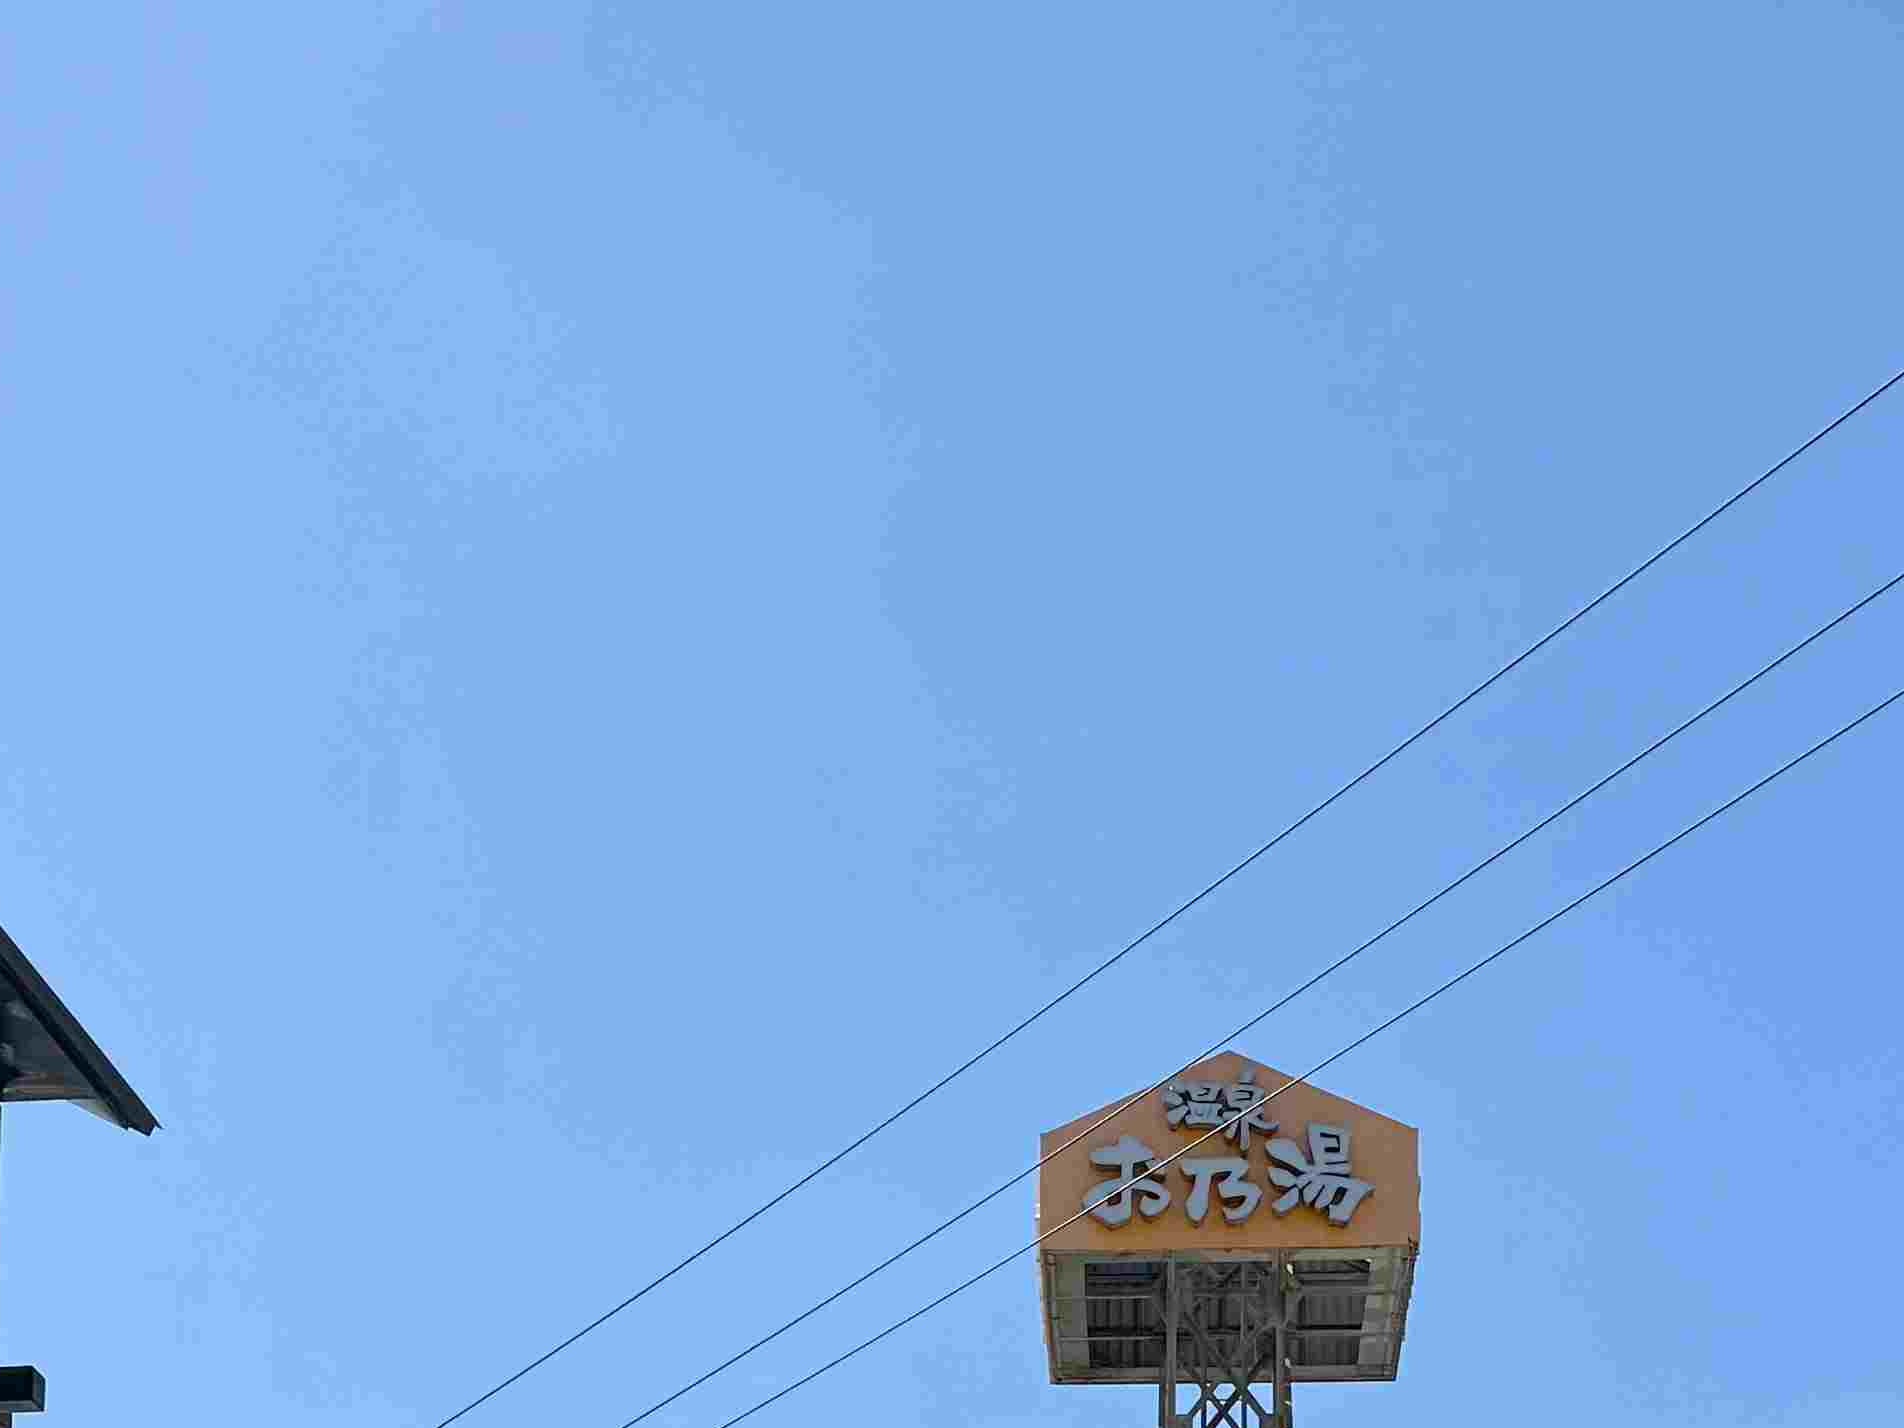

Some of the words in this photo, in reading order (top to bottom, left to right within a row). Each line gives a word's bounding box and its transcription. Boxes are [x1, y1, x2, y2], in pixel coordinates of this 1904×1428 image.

[1163, 1070, 1280, 1151] 温泉
[1082, 1122, 1375, 1228] お乃湯
